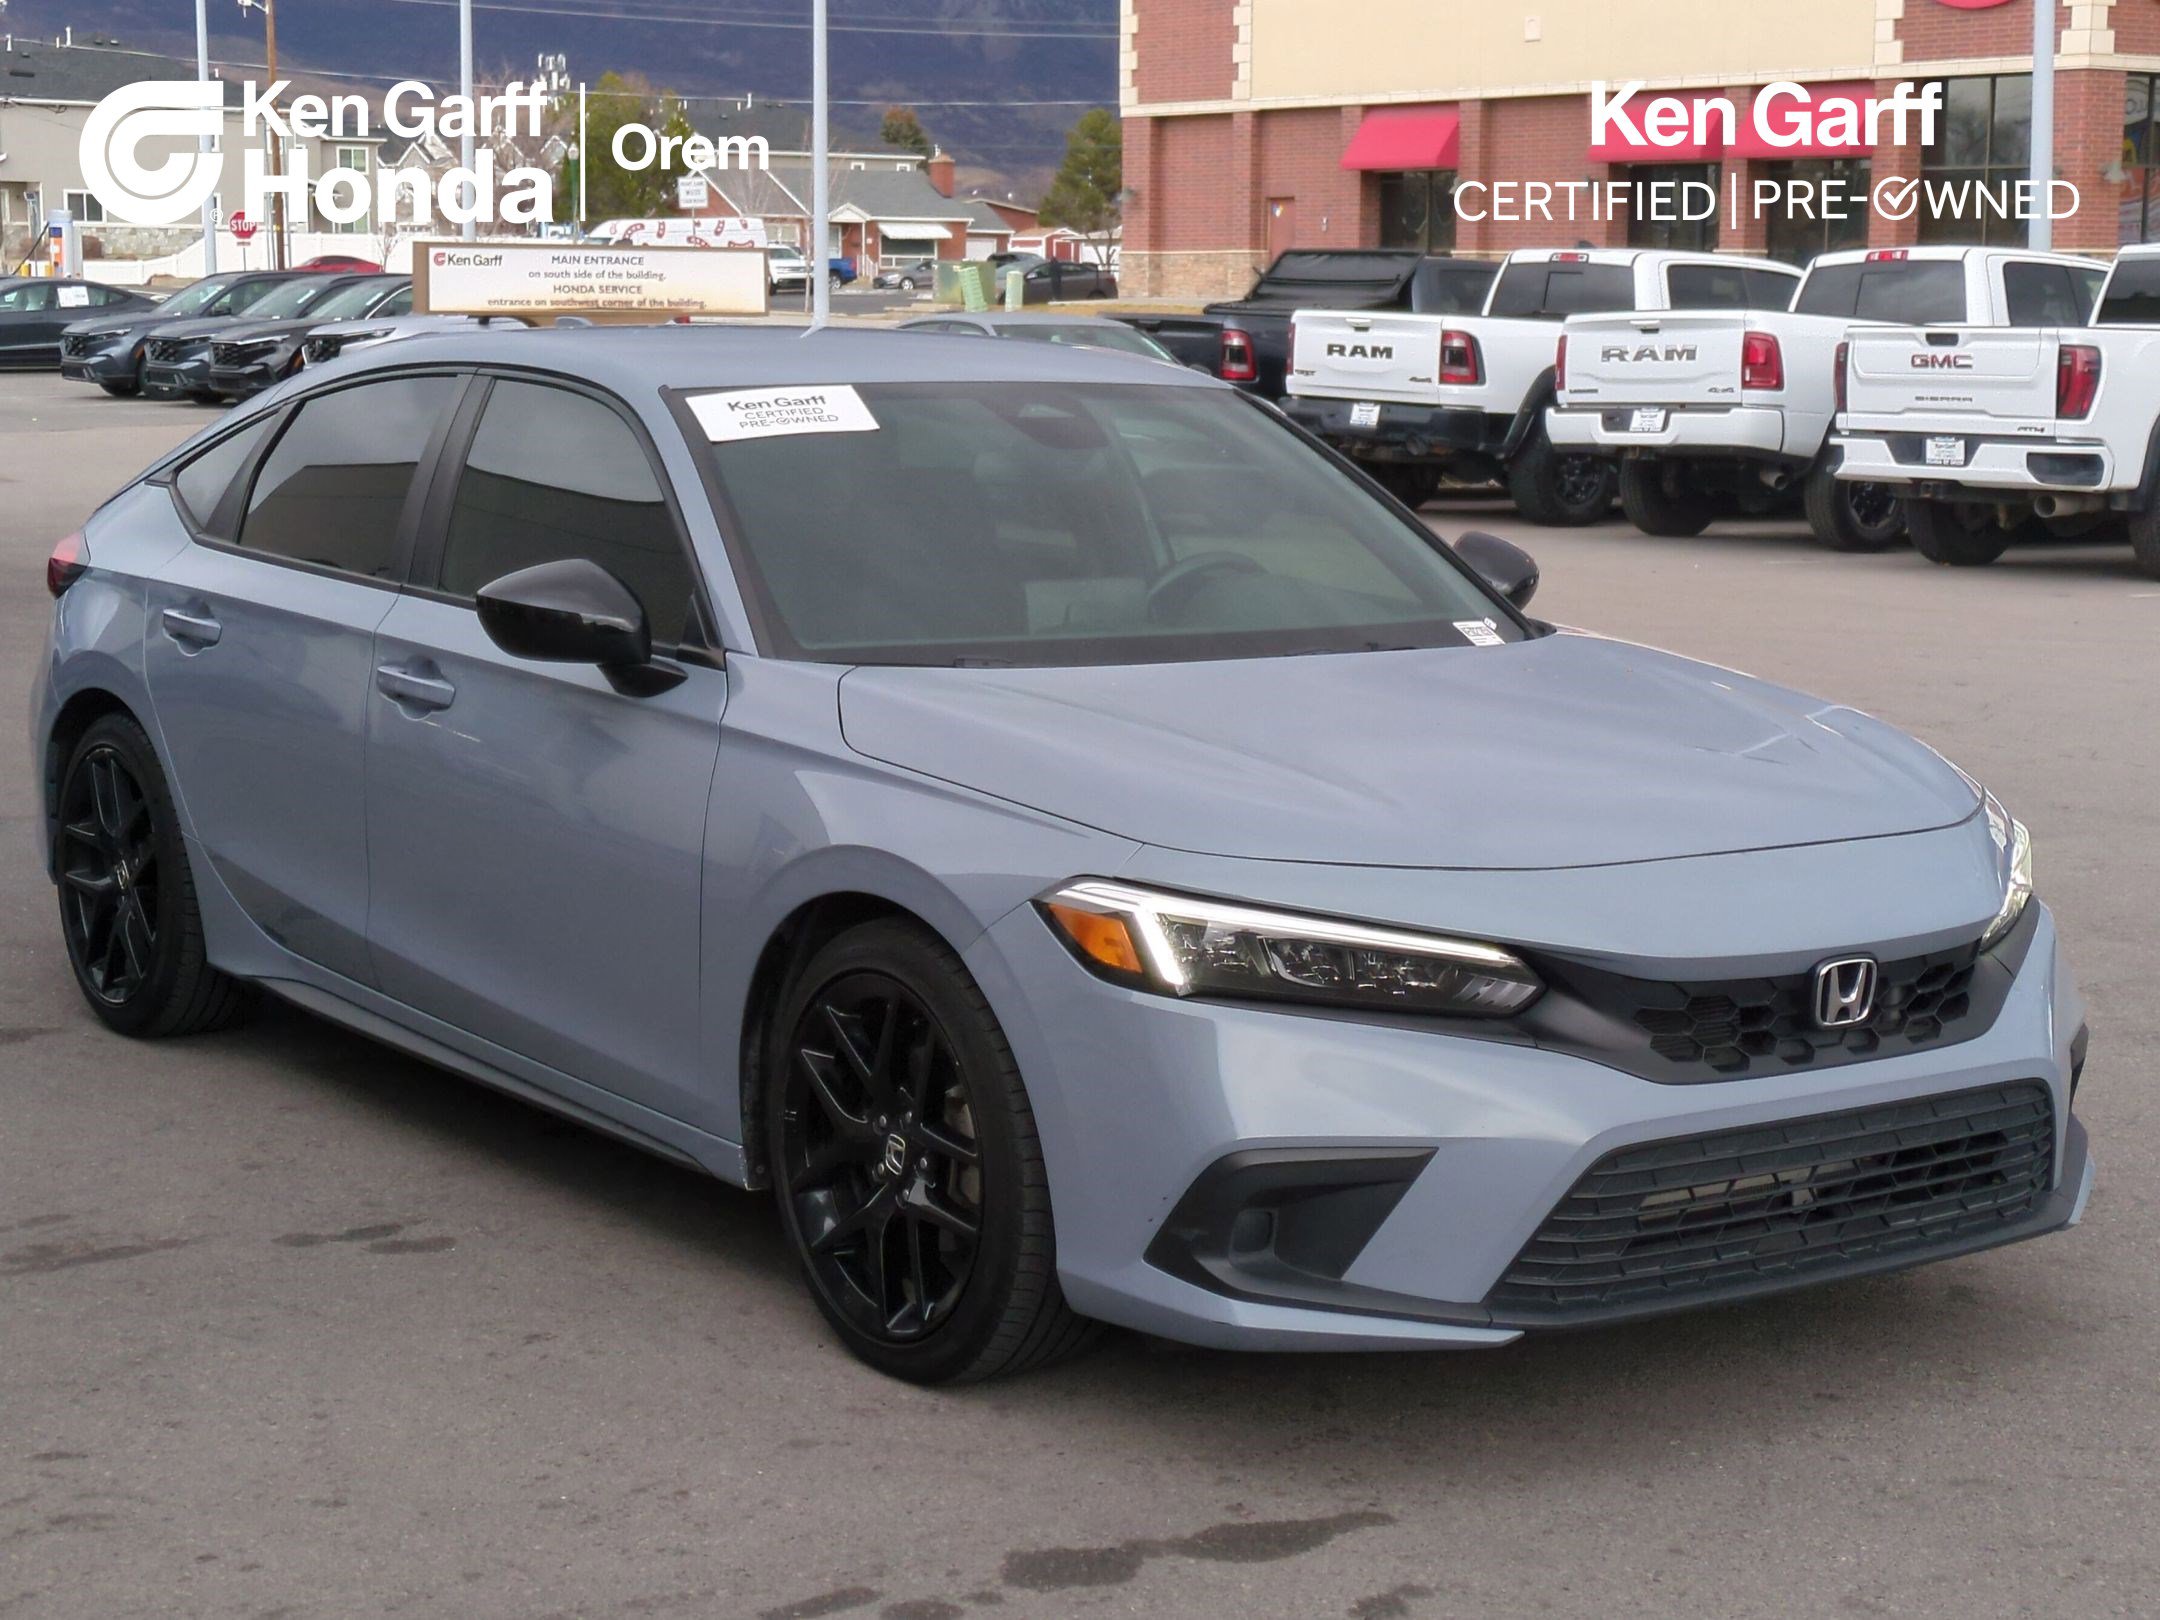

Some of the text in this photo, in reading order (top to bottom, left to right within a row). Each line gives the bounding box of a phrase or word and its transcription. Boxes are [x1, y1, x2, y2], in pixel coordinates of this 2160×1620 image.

[231, 219, 256, 231] STOP
[447, 254, 503, 266] Ken Garff
[551, 255, 644, 266] MAIN ENTRANCE
[544, 269, 571, 279] south
[574, 270, 592, 279] side
[595, 270, 606, 279] of
[607, 270, 623, 279] the
[553, 284, 643, 295] HONDA SERVICE
[487, 299, 532, 307] entrance
[550, 299, 598, 308] southwest
[602, 300, 633, 308] corner
[637, 299, 648, 308] of
[649, 299, 665, 308] the
[1326, 343, 1393, 360] RAM
[1601, 344, 1698, 363] RAM
[1910, 354, 1974, 369] GMC
[727, 395, 827, 412] Ken Garff
[744, 406, 824, 420] CERTIFIED
[739, 414, 839, 429] PRE-OWNED
